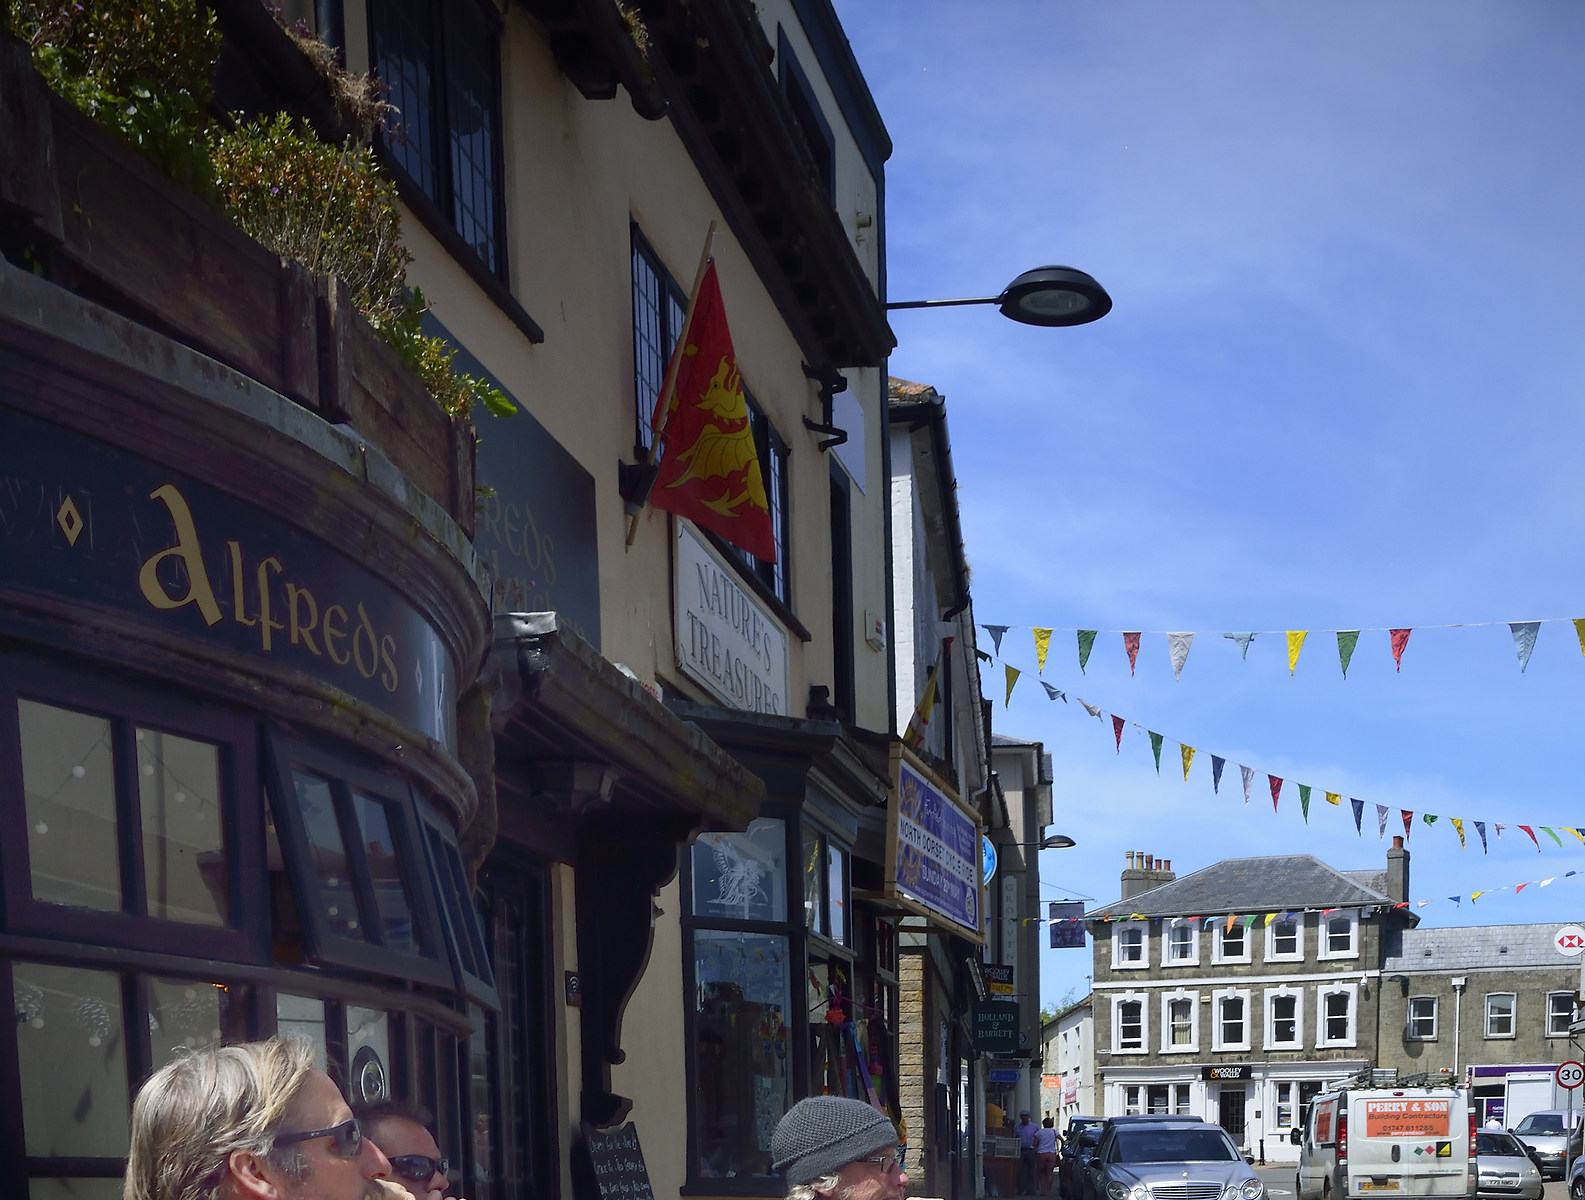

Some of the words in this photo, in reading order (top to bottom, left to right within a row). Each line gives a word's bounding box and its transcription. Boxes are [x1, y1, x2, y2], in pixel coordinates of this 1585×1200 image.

[695, 562, 772, 673] NATURE'S
[686, 608, 780, 716] TREASURES
[900, 818, 922, 846] NORTH
[978, 1012, 1014, 1022] HOLLAND
[978, 1029, 1013, 1039] BARRETT
[1561, 1069, 1582, 1081] 30
[1367, 1101, 1408, 1113] PERRY
[1411, 1102, 1421, 1112] &
[1424, 1101, 1448, 1112] SON
[1368, 1113, 1401, 1121] Building
[1402, 1112, 1448, 1120] Contractors
